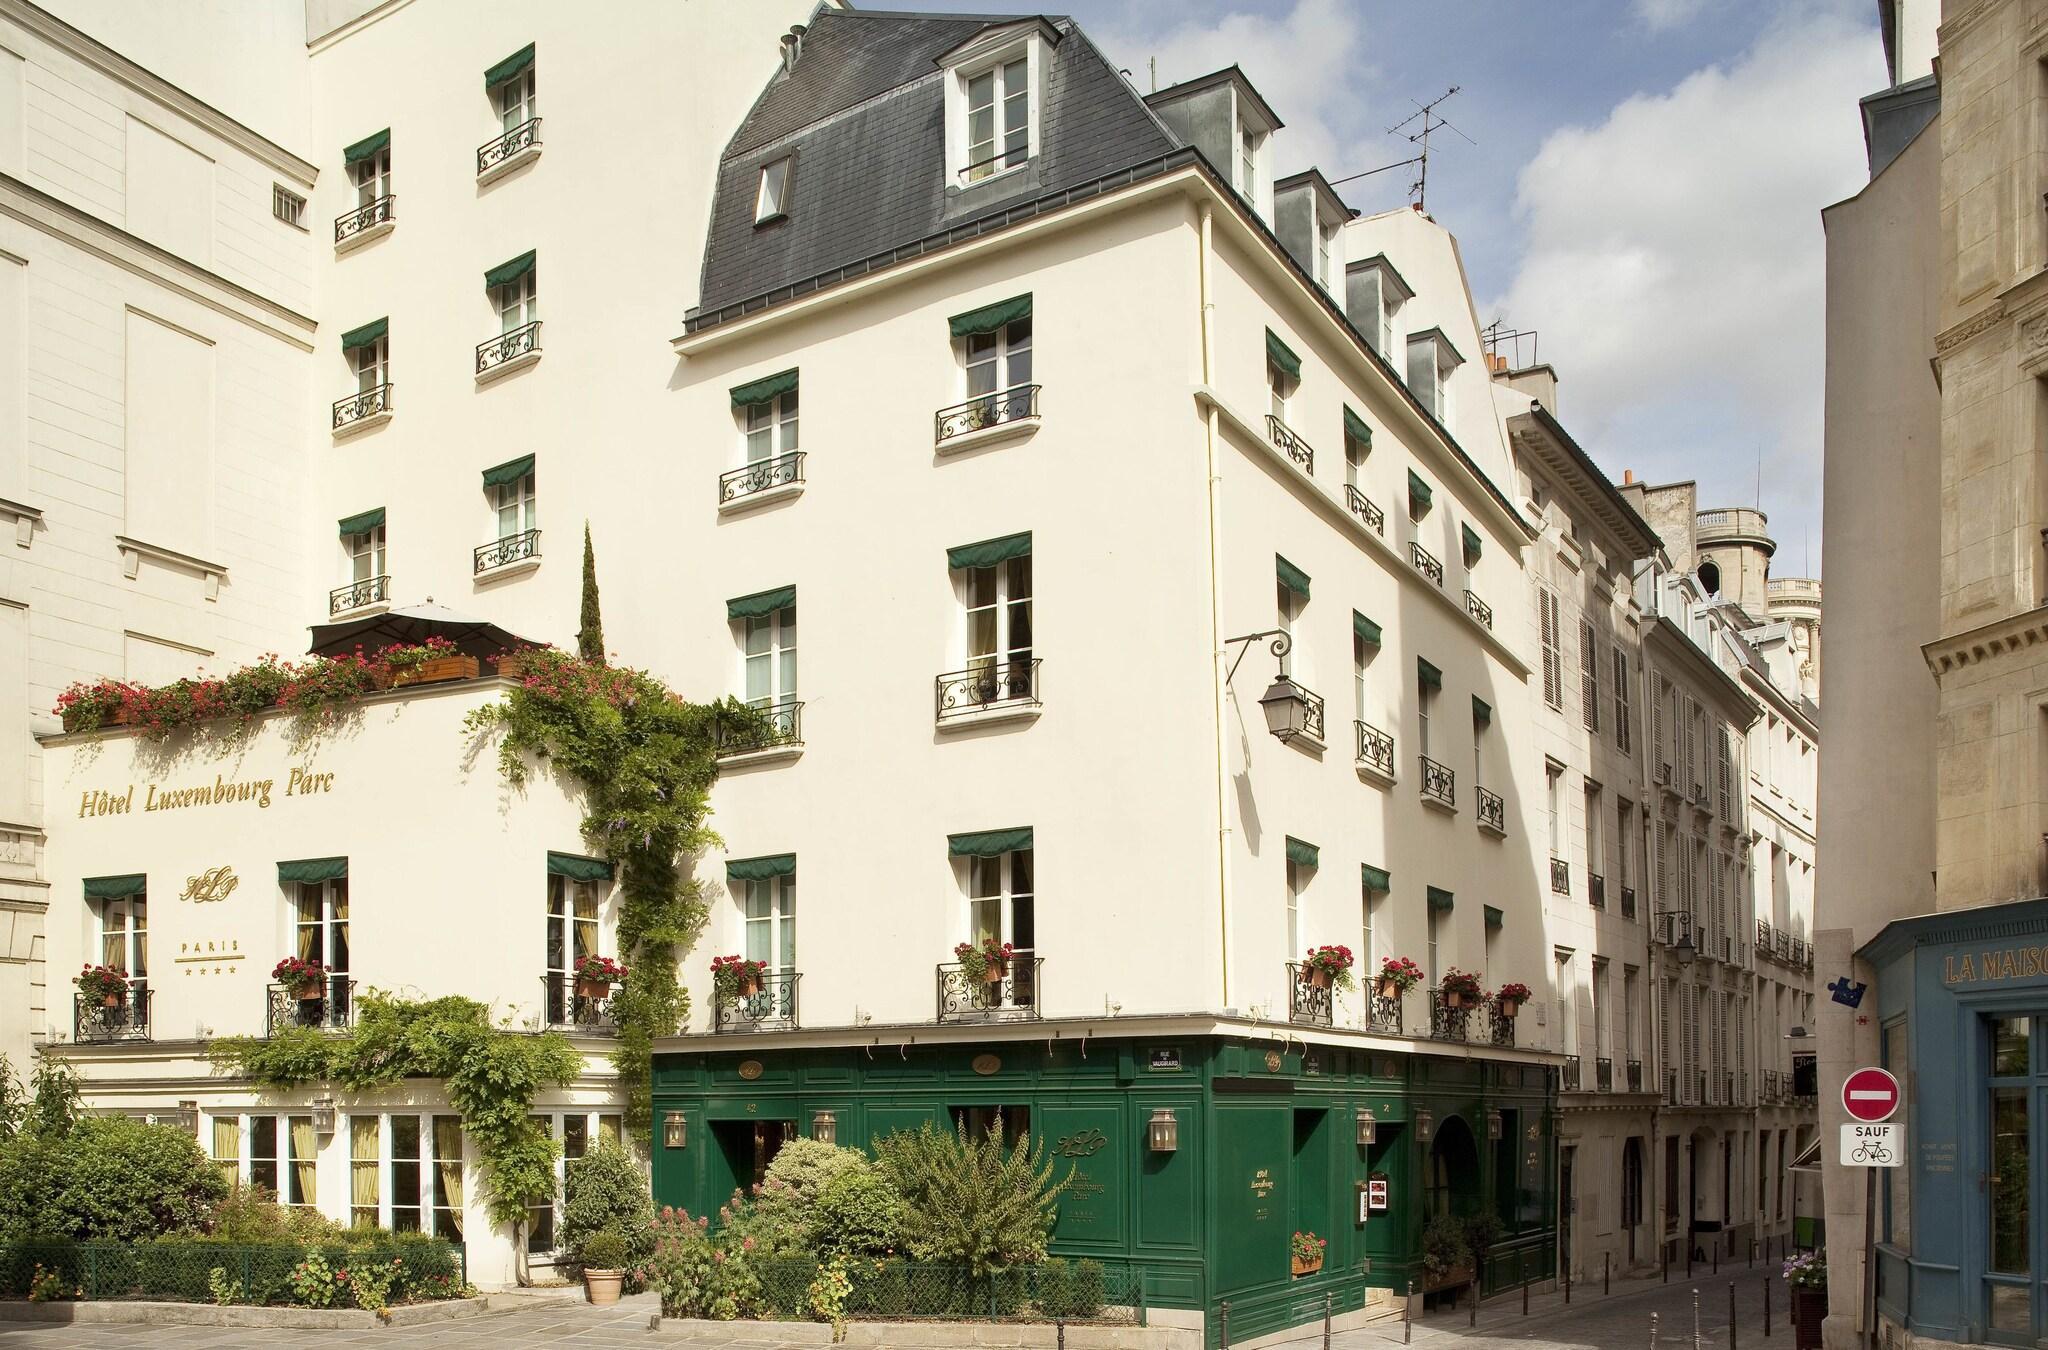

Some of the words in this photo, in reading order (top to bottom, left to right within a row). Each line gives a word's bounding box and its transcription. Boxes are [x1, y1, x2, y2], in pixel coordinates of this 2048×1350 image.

[78, 784, 134, 818] Hôtel
[144, 774, 273, 811] Luxembourg
[285, 767, 335, 797] Parc
[181, 940, 238, 953] PARIS
[1944, 954, 1977, 984] LA
[1855, 1126, 1890, 1137] SAUF
